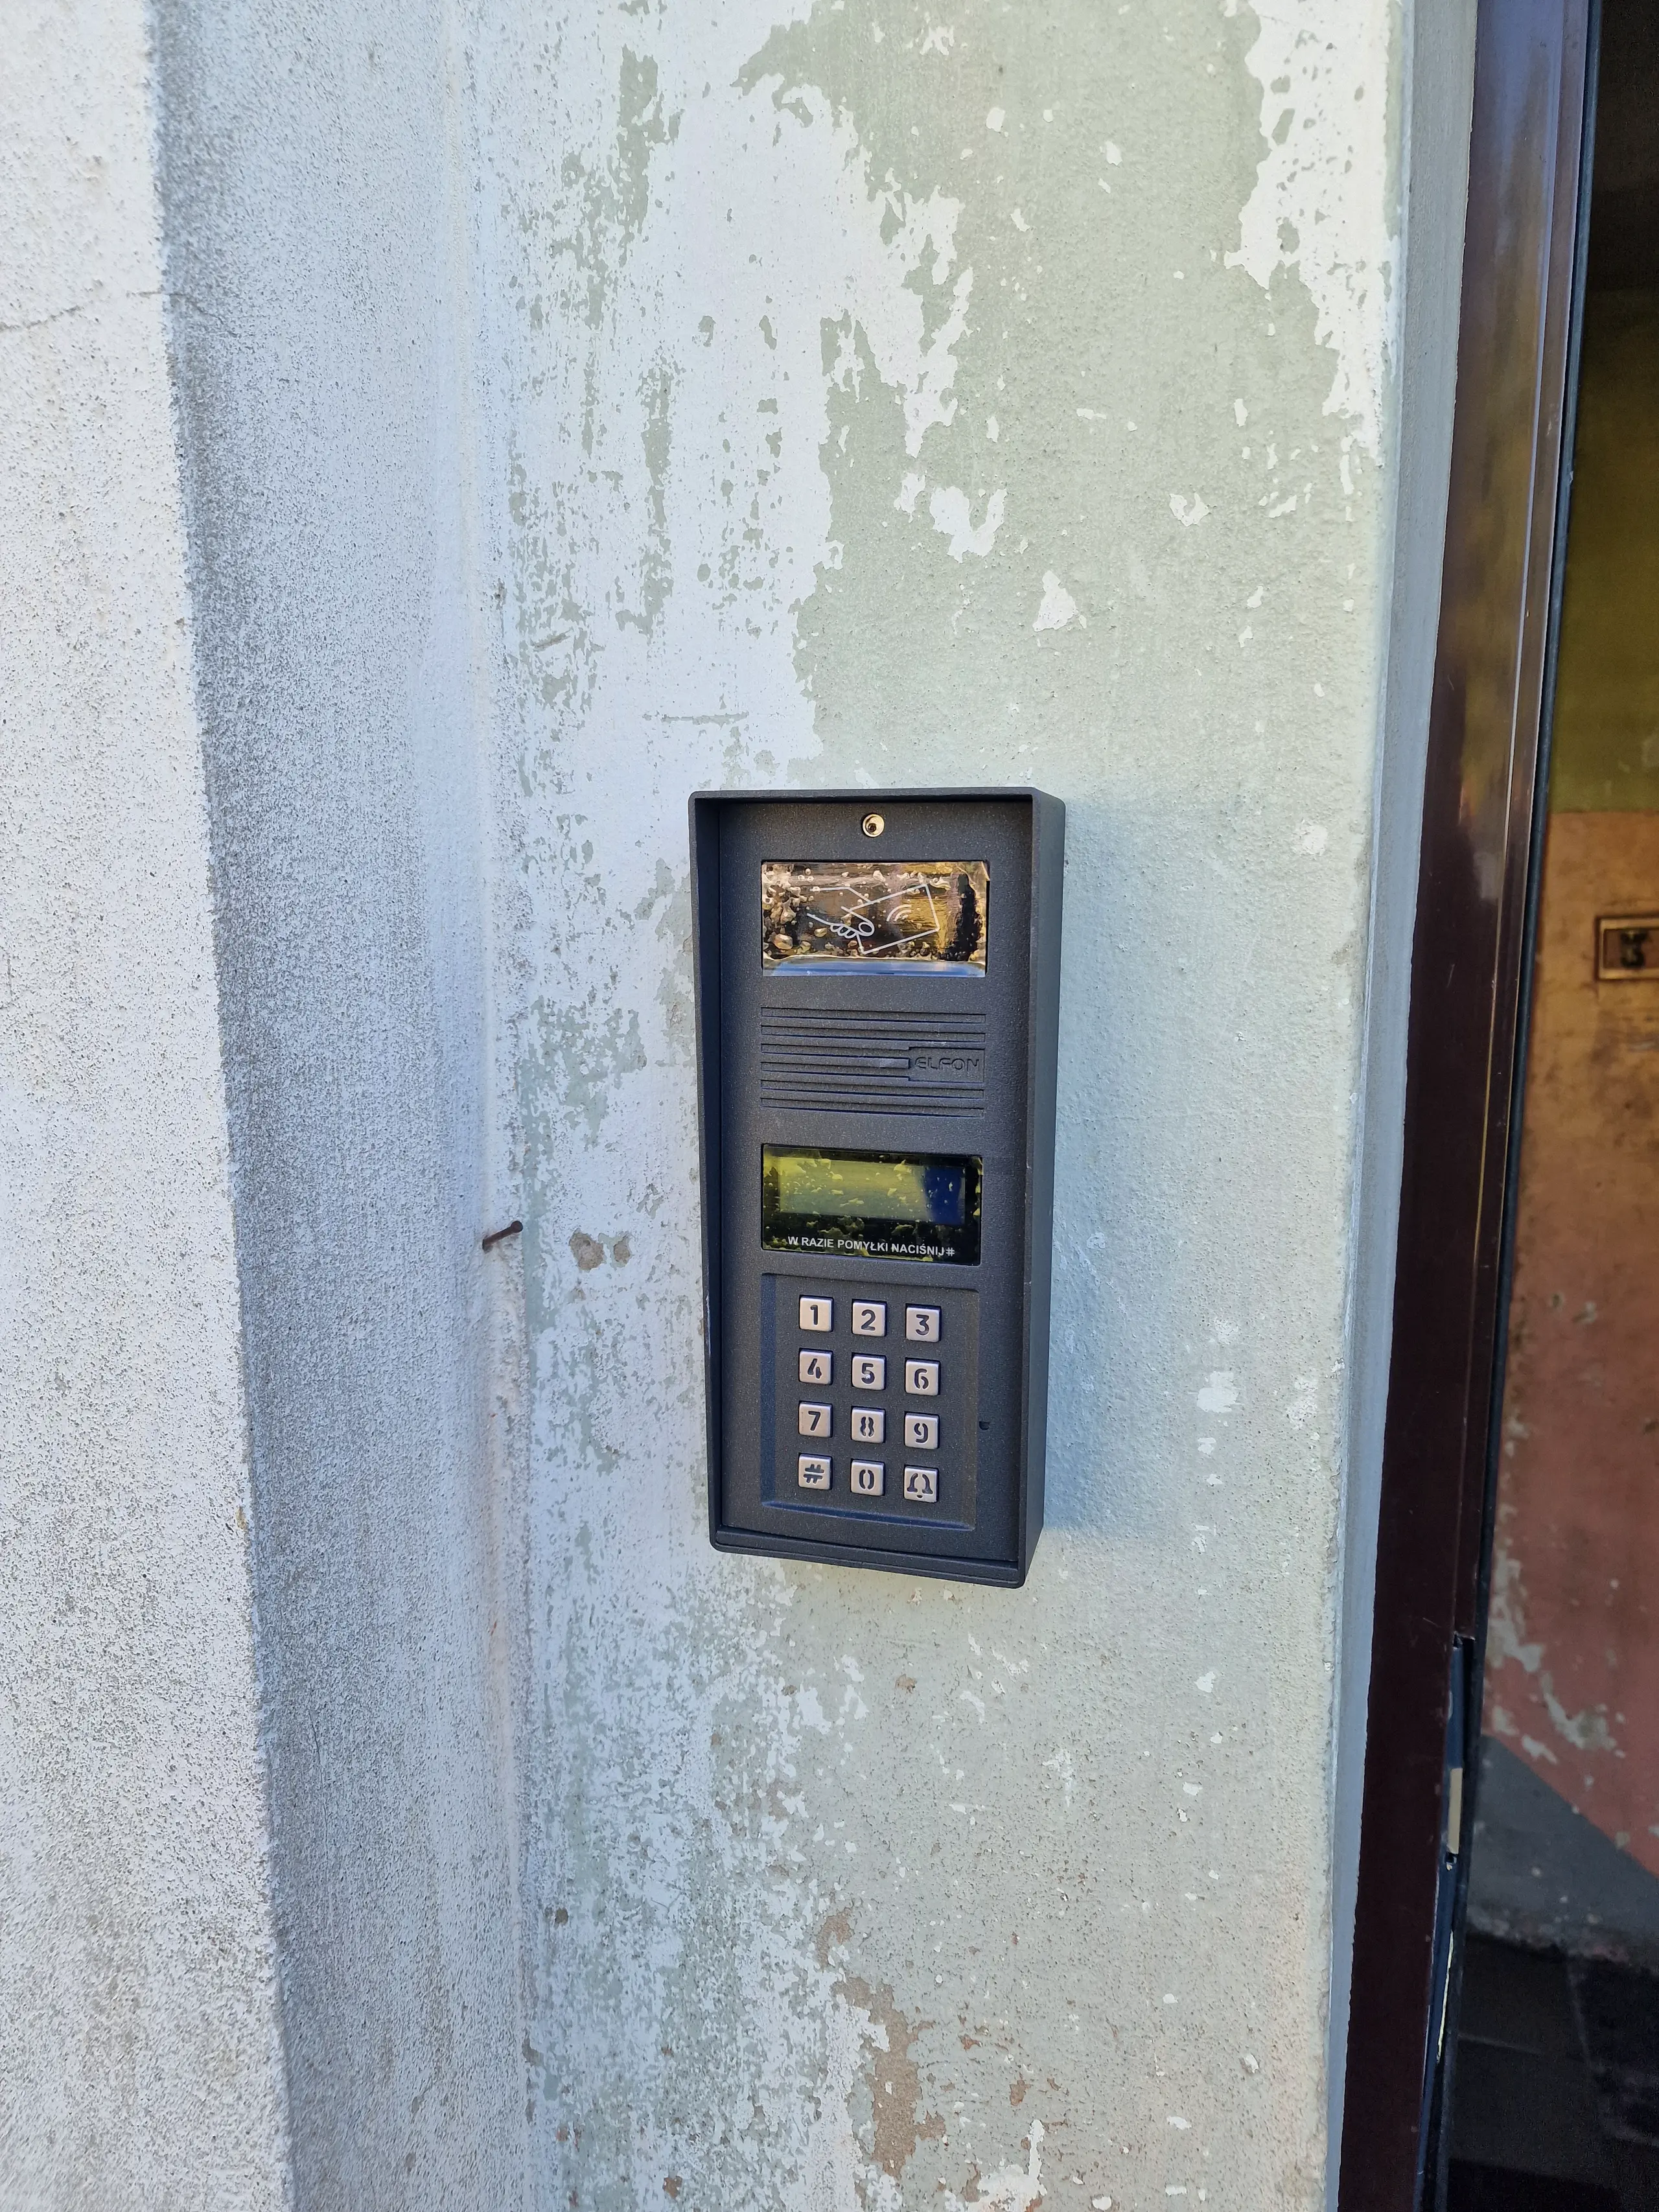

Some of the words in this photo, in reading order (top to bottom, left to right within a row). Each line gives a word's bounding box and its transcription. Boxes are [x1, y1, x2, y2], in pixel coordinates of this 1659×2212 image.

[914, 1056, 980, 1071] ELFON
[787, 1236, 799, 1246] W
[801, 1237, 835, 1248] RAZIE
[837, 1239, 888, 1252] POMYŁKI
[809, 1304, 818, 1325] 1
[860, 1309, 876, 1331] 2
[916, 1313, 929, 1336] 3
[807, 1357, 822, 1380] 4
[861, 1362, 876, 1384] 5
[914, 1368, 929, 1390] 6
[807, 1410, 822, 1432] 7
[859, 1415, 875, 1438] 8
[914, 1421, 929, 1444] 9
[803, 1463, 825, 1485] #
[859, 1468, 875, 1491] 0
